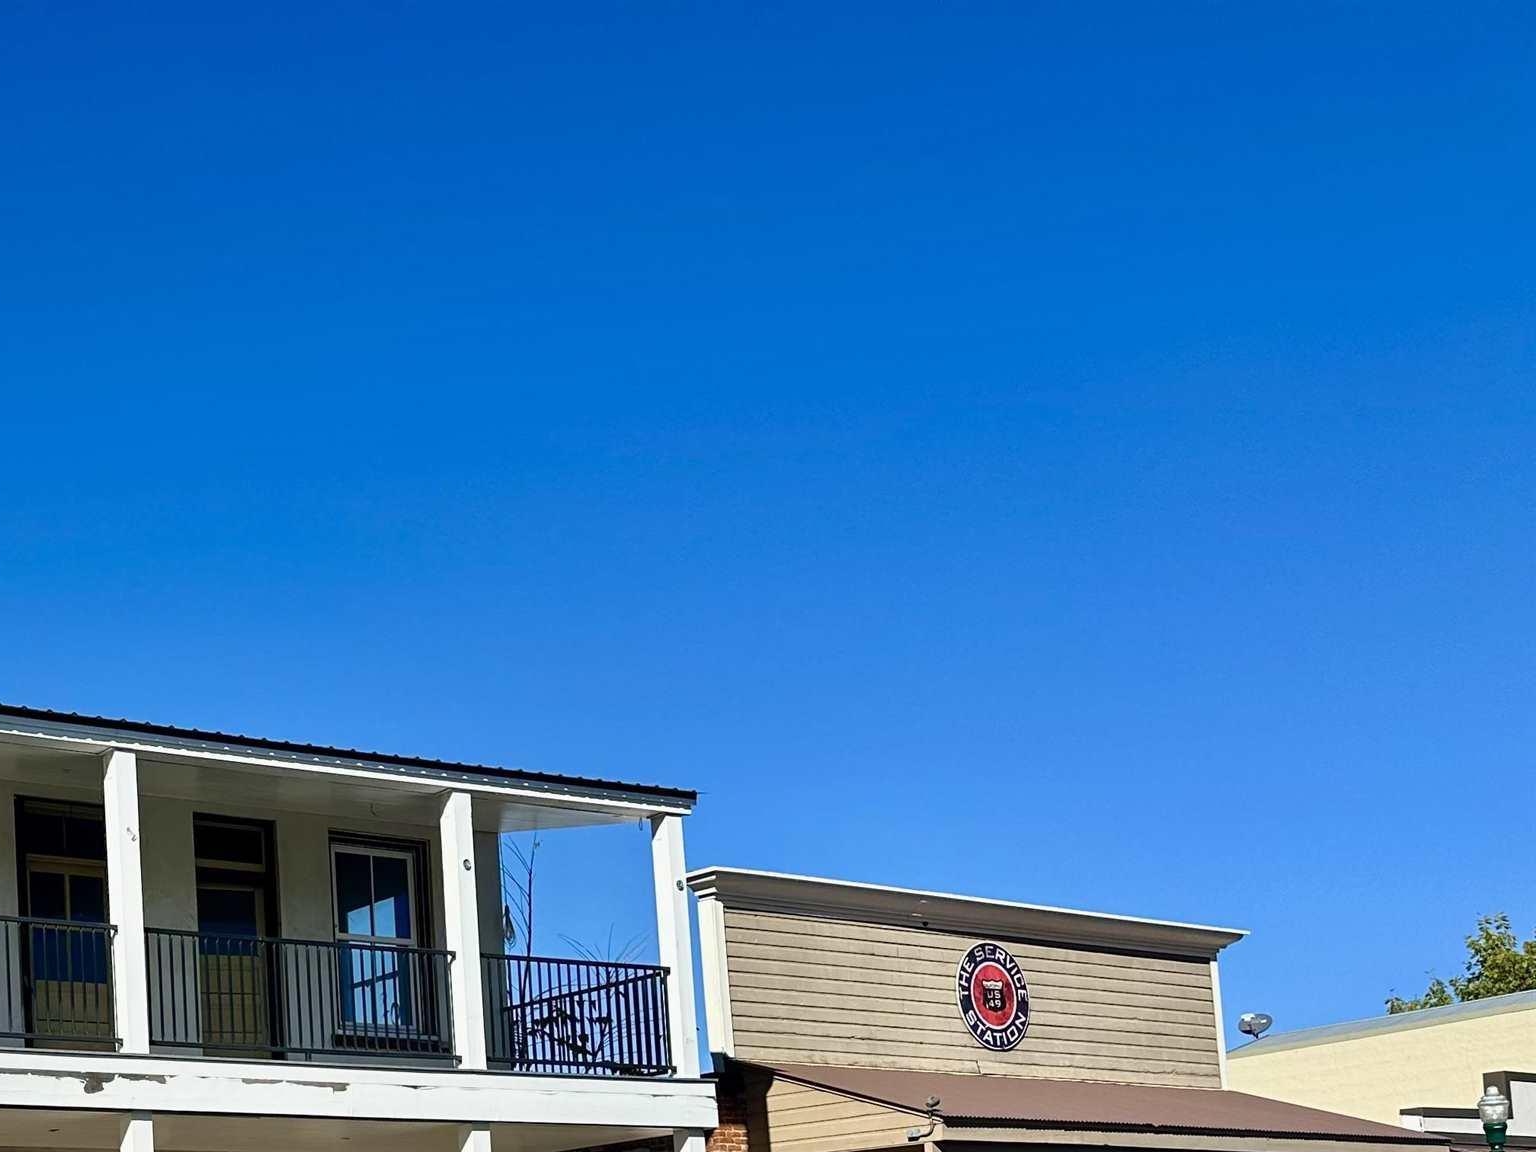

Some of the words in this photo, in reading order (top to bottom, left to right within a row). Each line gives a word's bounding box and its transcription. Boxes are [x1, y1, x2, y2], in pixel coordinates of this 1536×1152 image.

[959, 957, 975, 1000] THE
[974, 945, 1028, 1002] SERVICE
[987, 989, 1001, 999] US
[989, 1000, 1002, 1008] 49
[966, 1010, 1027, 1046] STATION
